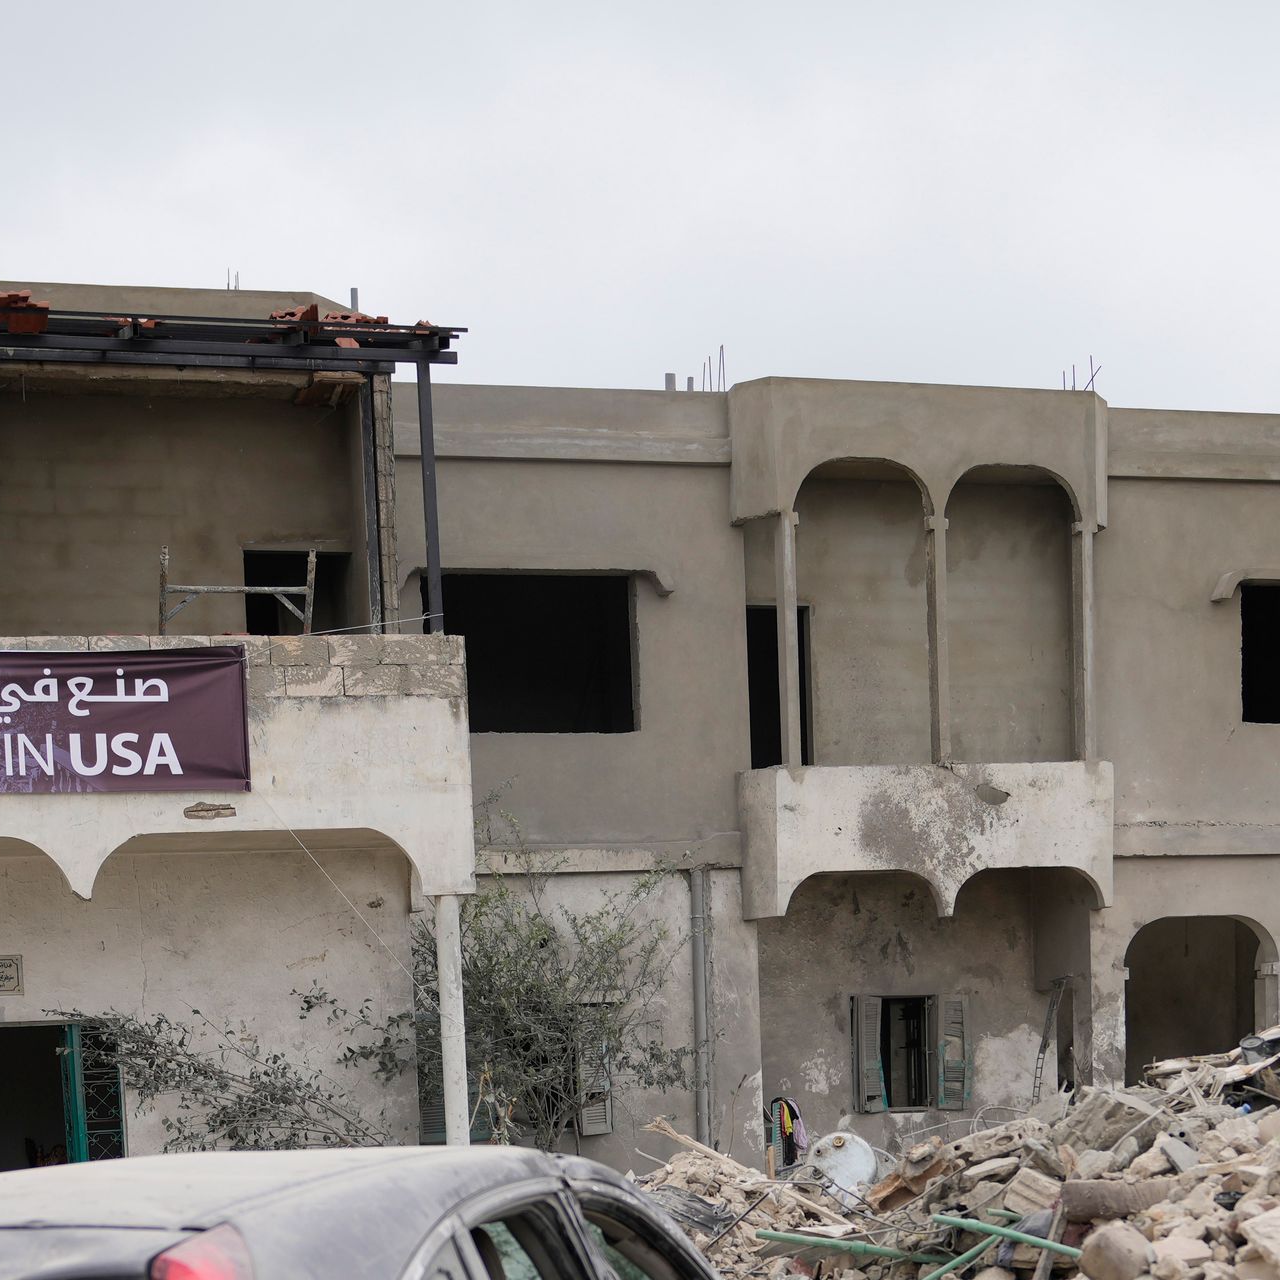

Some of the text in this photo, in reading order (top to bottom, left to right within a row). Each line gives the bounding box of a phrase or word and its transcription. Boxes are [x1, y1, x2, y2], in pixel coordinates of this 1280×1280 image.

[66, 667, 169, 717] صنع
[4, 733, 55, 776] IN
[69, 732, 184, 776] USA
